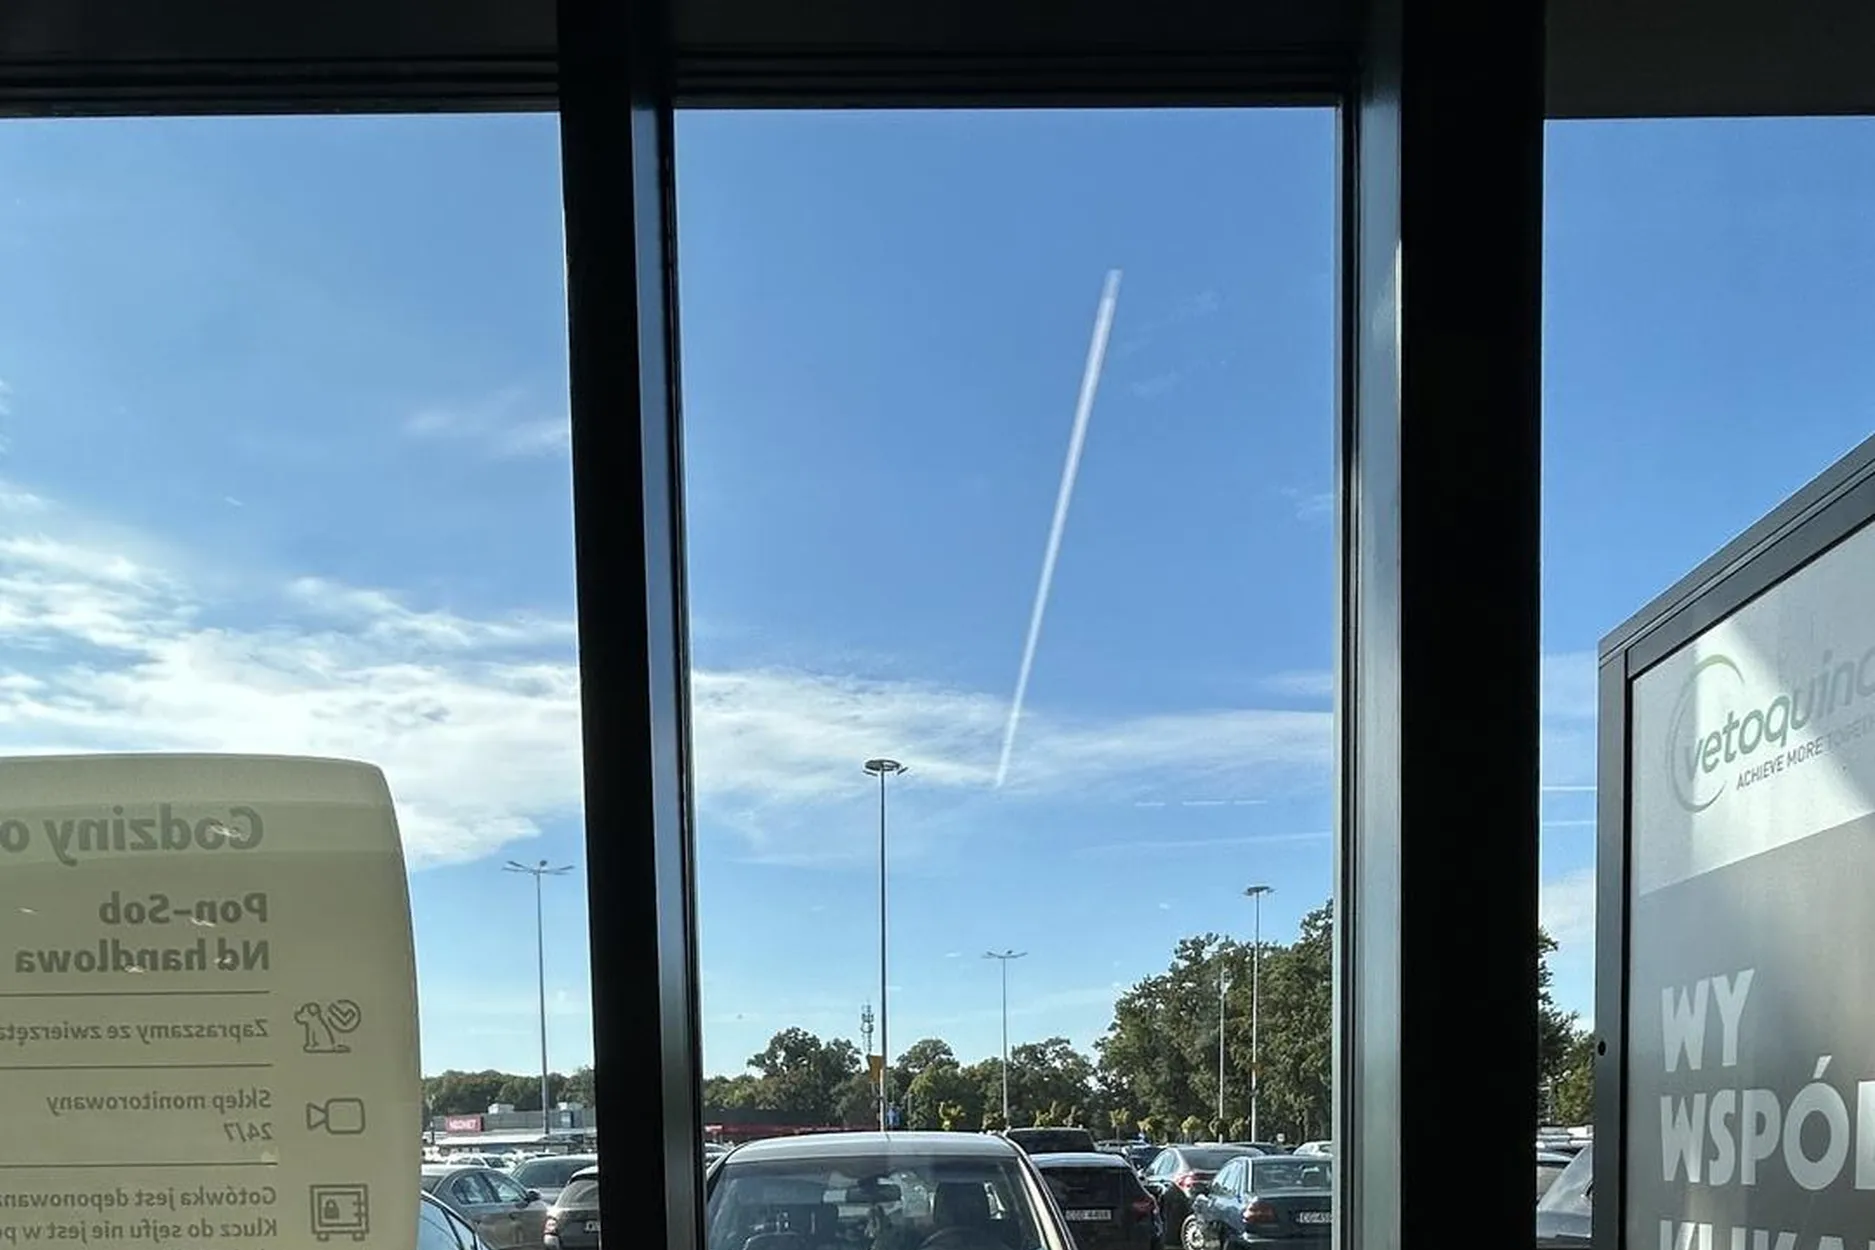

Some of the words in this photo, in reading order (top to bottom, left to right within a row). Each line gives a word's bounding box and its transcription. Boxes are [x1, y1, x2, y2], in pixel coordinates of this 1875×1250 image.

[1736, 755, 1784, 791] ACHIEVE
[1786, 737, 1823, 770] MORE
[1661, 968, 1756, 1073] WY
